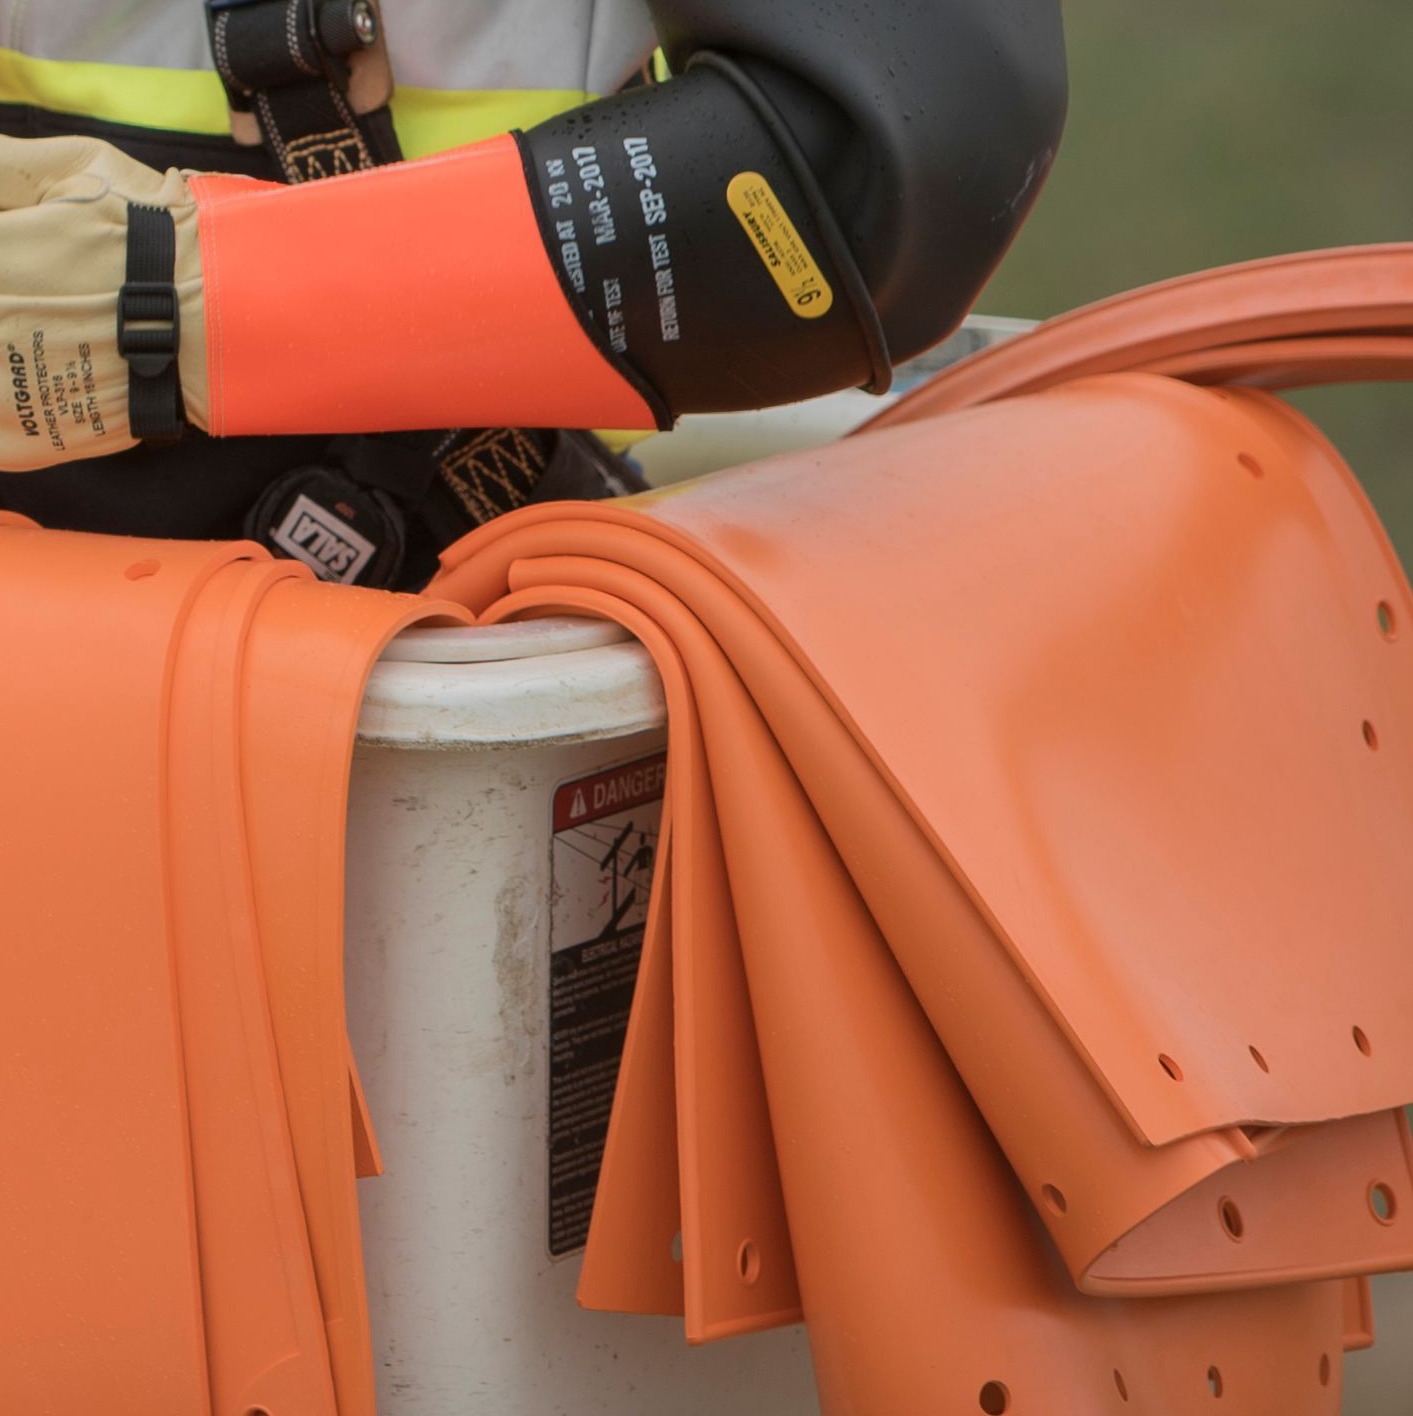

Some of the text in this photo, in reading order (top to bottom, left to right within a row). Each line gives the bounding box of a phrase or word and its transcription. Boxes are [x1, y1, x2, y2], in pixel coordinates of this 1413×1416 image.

[548, 181, 573, 208] 20
[572, 146, 616, 246] MAR-2017
[556, 219, 576, 240] AT
[623, 136, 680, 342] RETURN FOR TEST SEP-2017
[743, 212, 781, 267] SALISBURY
[603, 277, 622, 308] TEST
[607, 308, 625, 326] OF
[78, 342, 93, 384] INCHES
[33, 330, 66, 452] LEATHER PROTECTORS
[72, 401, 86, 424] SIZE
[86, 396, 106, 437] LENGTH
[292, 515, 357, 572] SALA
